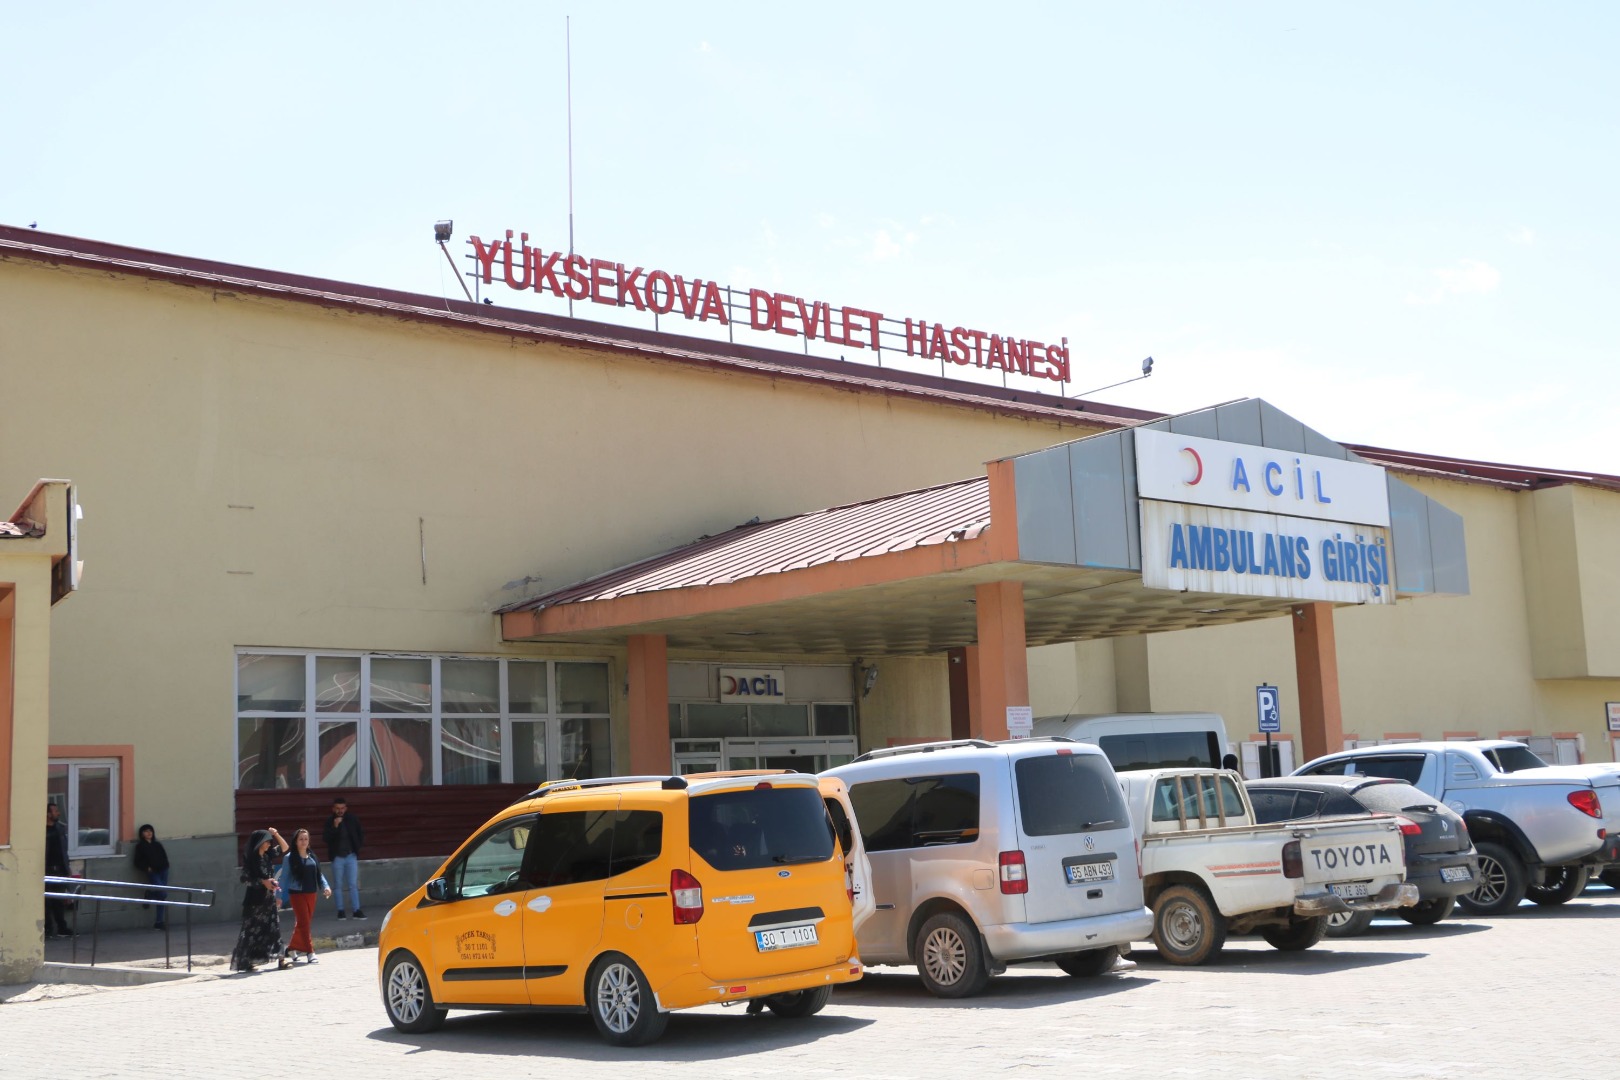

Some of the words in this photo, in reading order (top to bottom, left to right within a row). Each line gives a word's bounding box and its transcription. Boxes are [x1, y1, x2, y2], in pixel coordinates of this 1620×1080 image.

[470, 229, 728, 325] YÜKSEKOVA
[750, 288, 883, 350] DEVLET
[905, 317, 1071, 383] HASTANESİ
[1232, 457, 1331, 503] ACİL
[1170, 523, 1311, 580] AMBULANS
[1320, 533, 1388, 596] GİRİŞİ
[736, 674, 783, 696] ACİL
[1259, 691, 1274, 721] P
[1311, 843, 1391, 870] TOYOTA
[1071, 867, 1082, 879] 65
[1083, 865, 1098, 877] ABN
[1098, 863, 1112, 876] 493
[762, 933, 776, 946] 30
[780, 930, 787, 943] T
[792, 927, 815, 942] 1101
